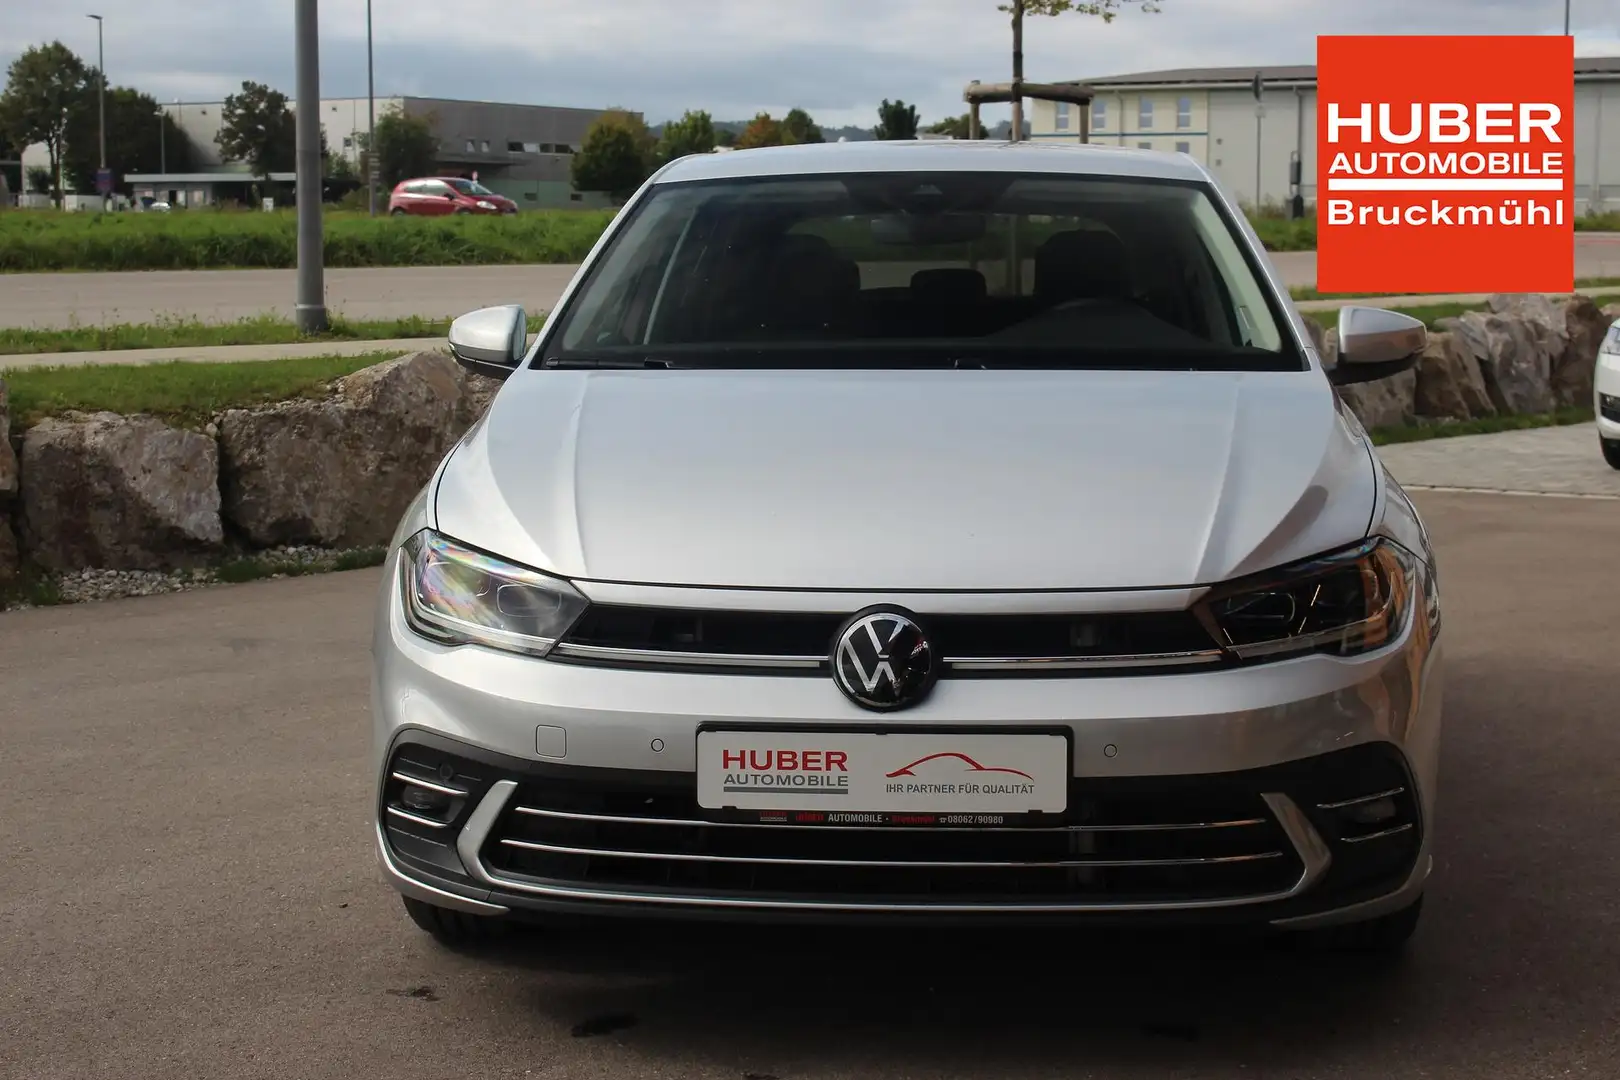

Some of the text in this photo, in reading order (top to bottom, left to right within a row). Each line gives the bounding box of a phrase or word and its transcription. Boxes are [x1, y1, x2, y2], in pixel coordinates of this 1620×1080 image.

[722, 749, 848, 772] HUBER
[723, 773, 849, 787] AUTOMOBILE
[886, 782, 1034, 795] IHR PARTNER FÜR QUALITÄT
[828, 813, 883, 823] AUTOMOBILE
